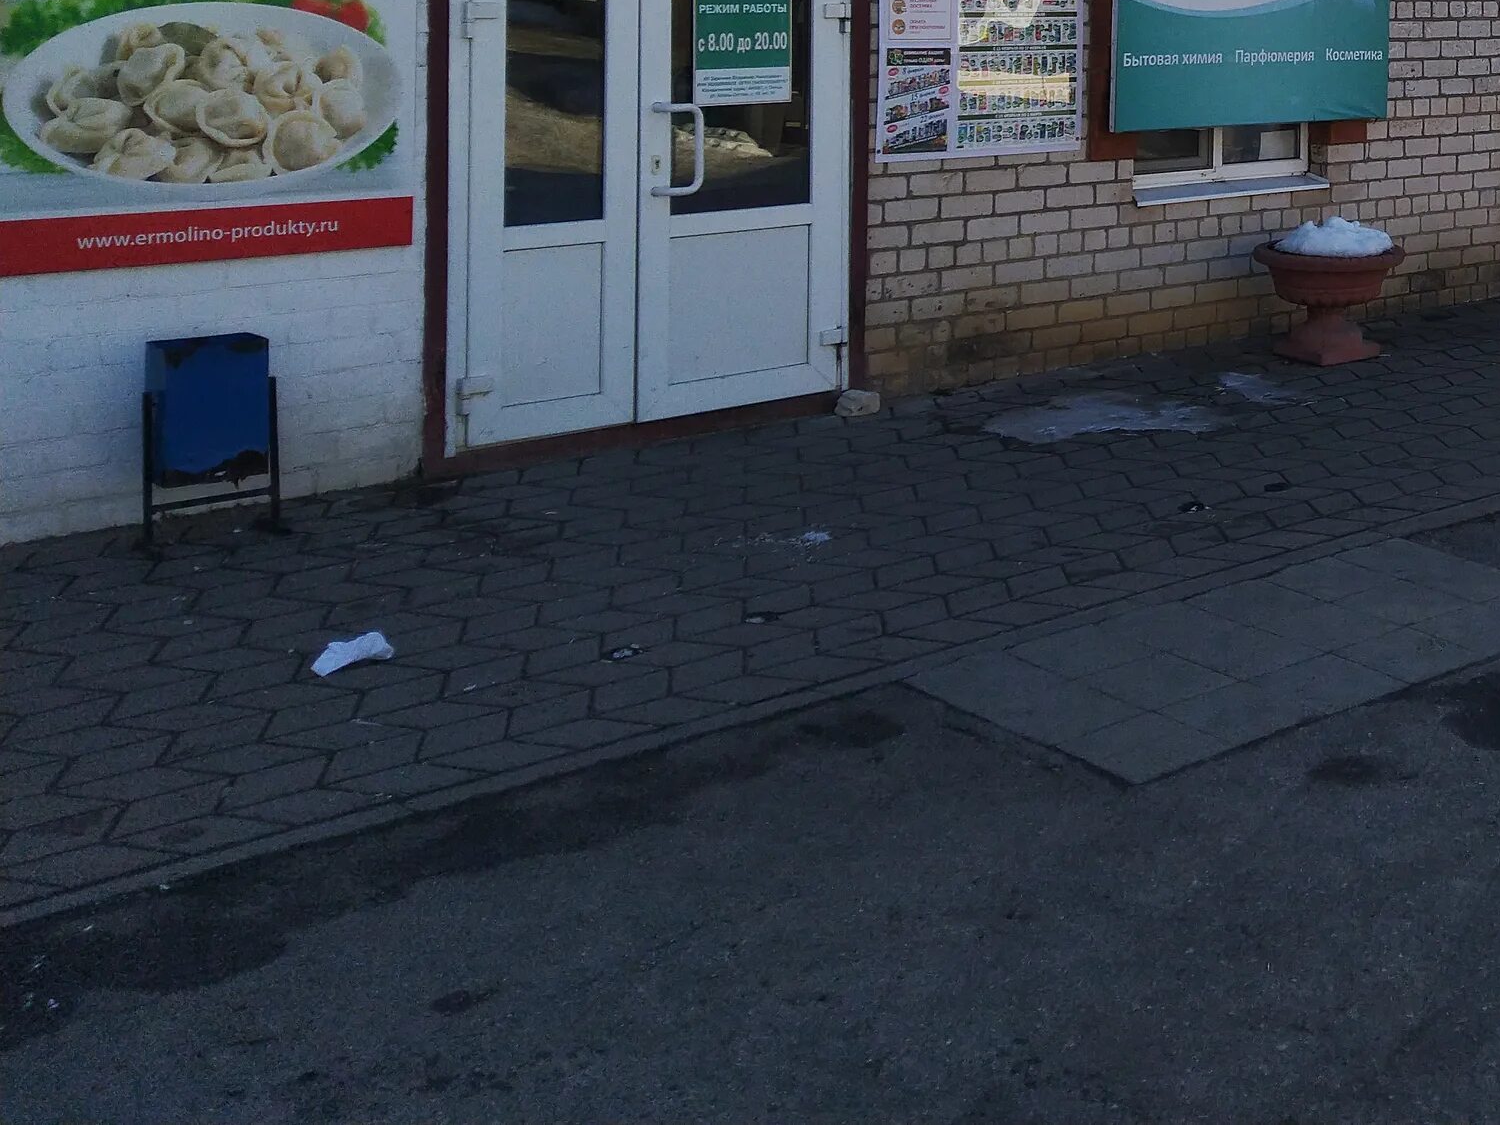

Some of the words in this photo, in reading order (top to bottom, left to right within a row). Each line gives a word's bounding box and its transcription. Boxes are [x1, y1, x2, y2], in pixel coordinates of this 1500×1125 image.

[699, 4, 739, 14] РЕЖИМ
[743, 3, 787, 14] РАБОТЫ
[698, 38, 705, 52] с
[708, 33, 734, 52] 8.00
[737, 37, 751, 53] до
[755, 31, 788, 50] 20.00
[1123, 52, 1179, 67] Бытовая
[1182, 52, 1223, 65] химия
[1235, 49, 1315, 65] Парфюмерия
[1325, 47, 1383, 62] Косметика
[77, 219, 339, 250] www.ermolino-produkty.ru
